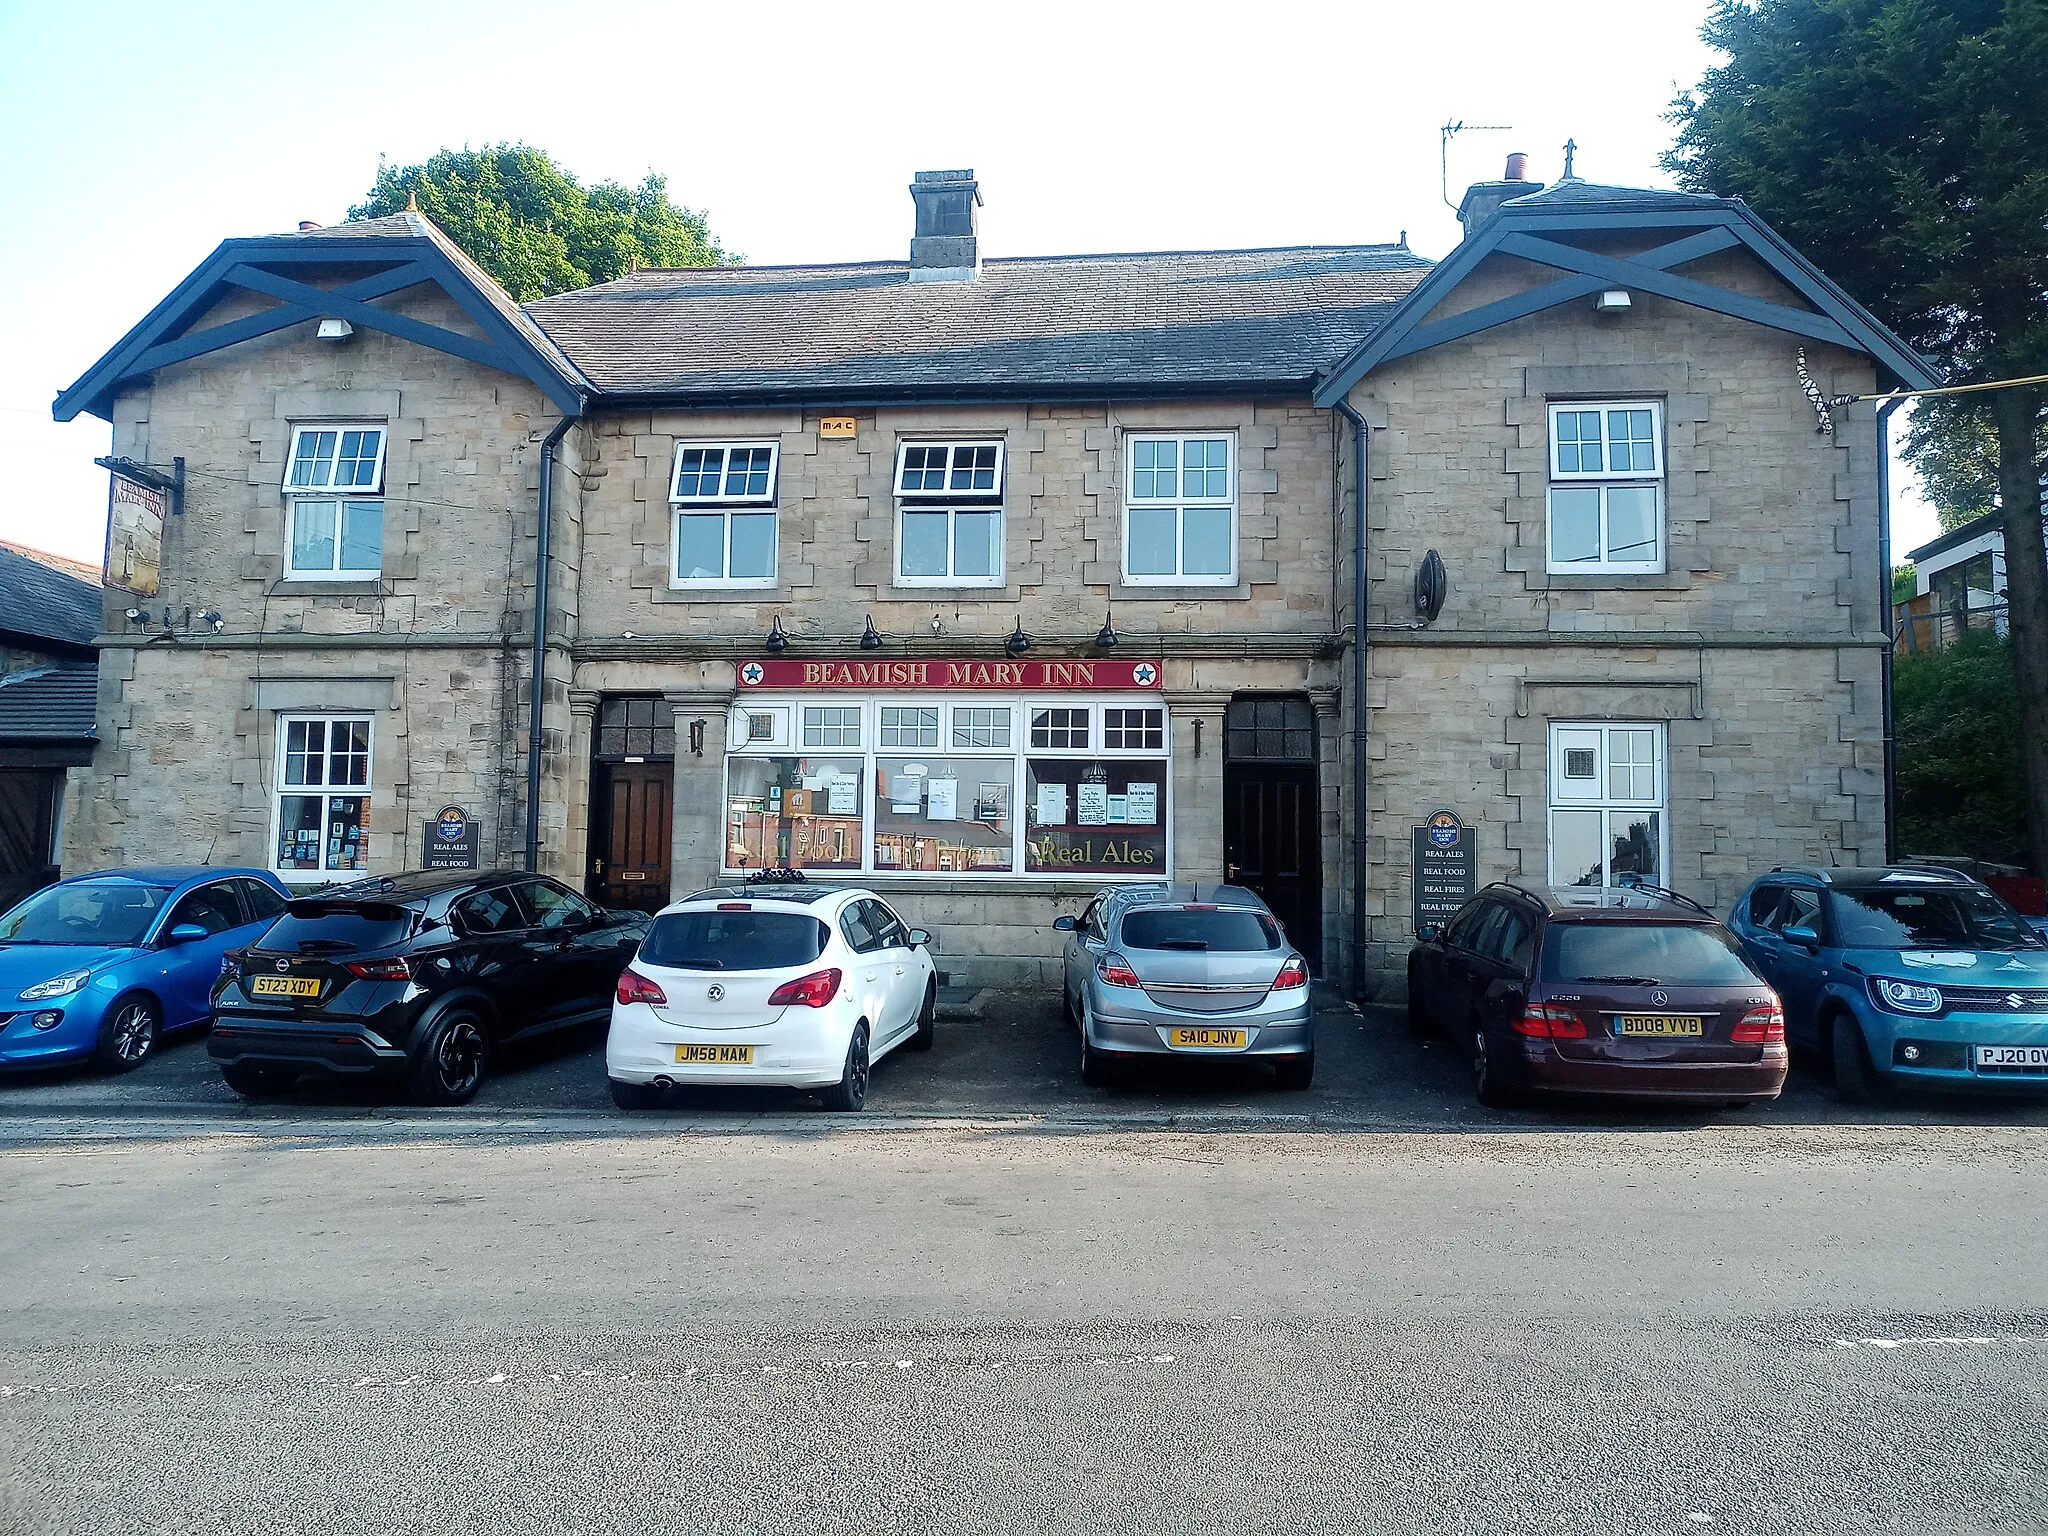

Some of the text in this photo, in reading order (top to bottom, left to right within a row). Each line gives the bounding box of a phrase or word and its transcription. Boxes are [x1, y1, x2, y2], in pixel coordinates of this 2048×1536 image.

[120, 480, 160, 503] BEAMISH
[145, 501, 164, 521] INN
[802, 663, 1096, 686] BEAMISH MARY INN
[1038, 840, 1154, 864] Real Ales
[1425, 850, 1445, 858] REAL
[1444, 868, 1466, 876] FOOD
[1421, 903, 1463, 911] REAL PEOP
[258, 979, 315, 993] ST23 XDY
[1624, 1018, 1664, 1032] BD08
[1668, 1019, 1698, 1032] VVB
[1180, 1030, 1237, 1044] SA10 JNV
[681, 1047, 748, 1062] JM58 MAM
[1983, 1049, 2027, 1063] PJ20
